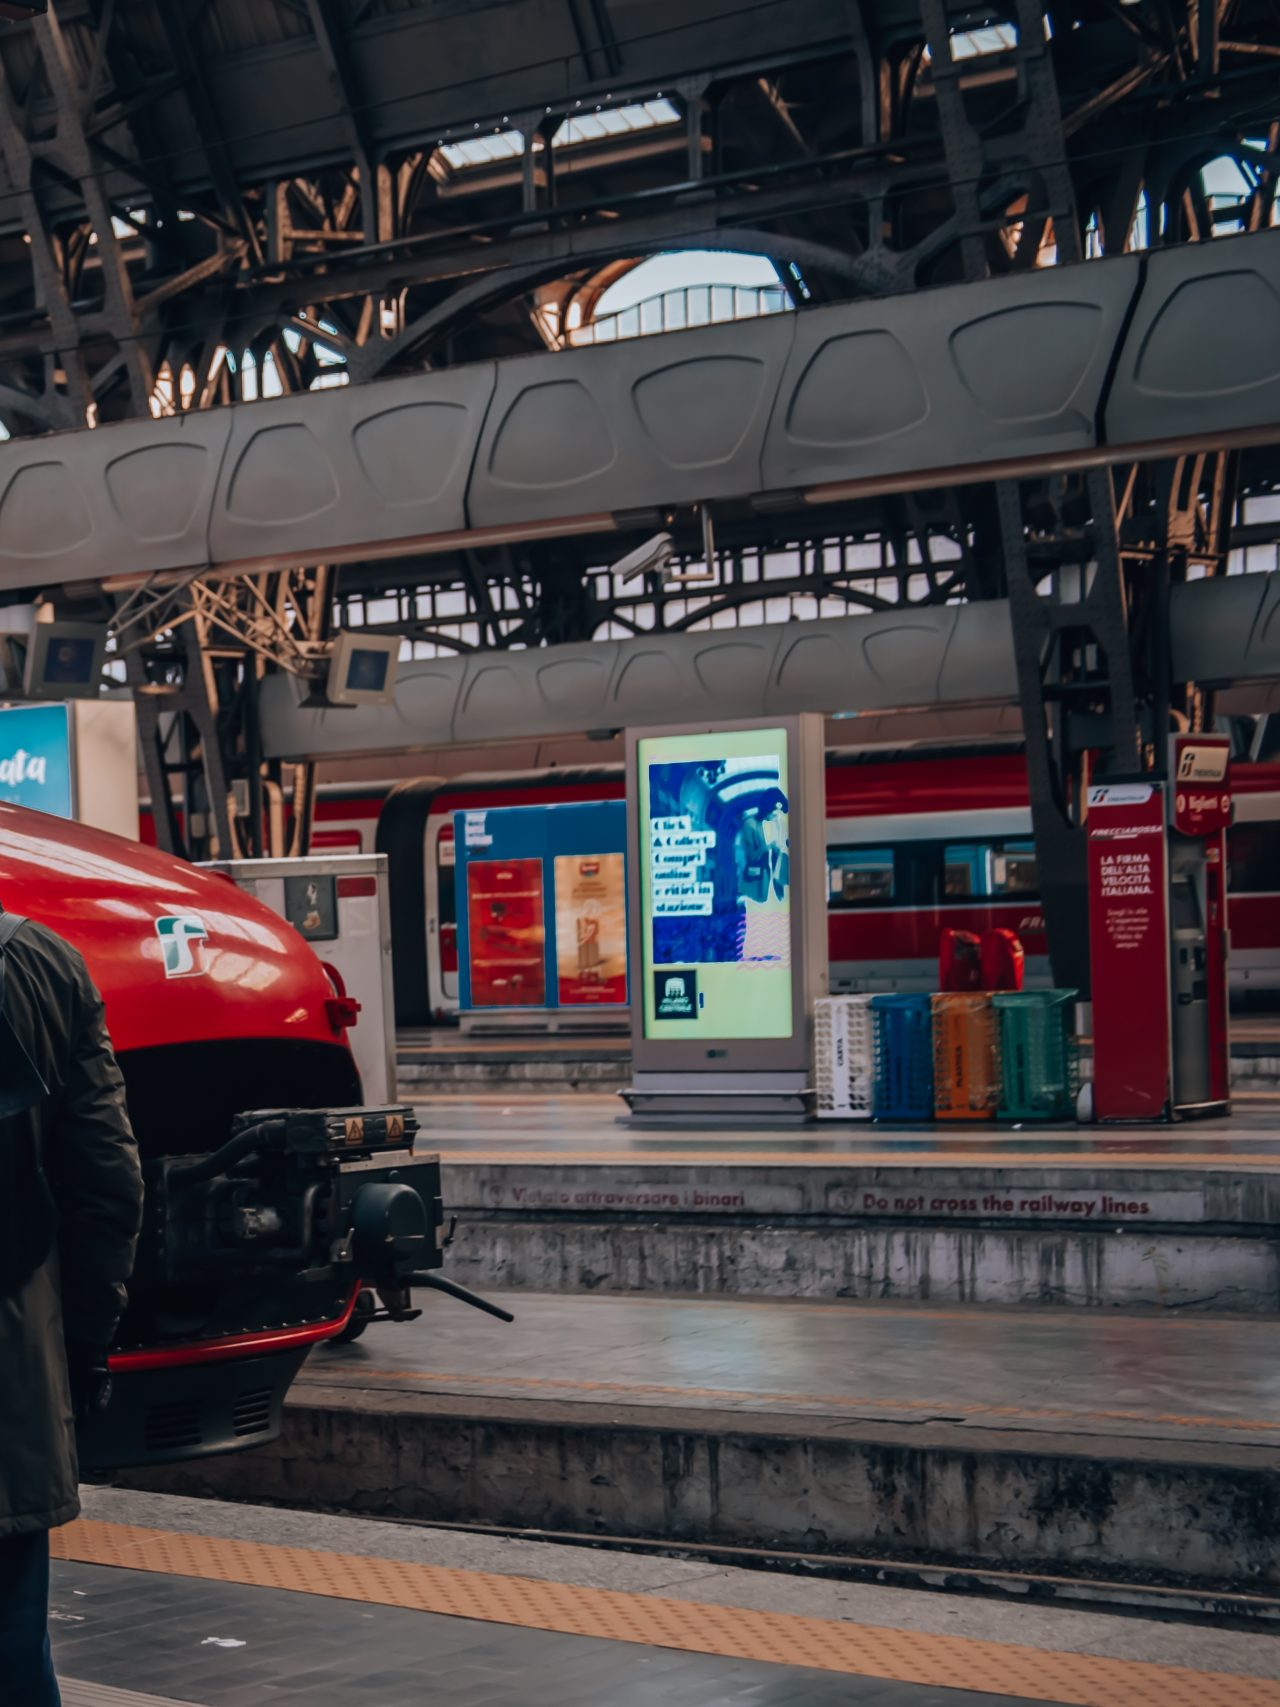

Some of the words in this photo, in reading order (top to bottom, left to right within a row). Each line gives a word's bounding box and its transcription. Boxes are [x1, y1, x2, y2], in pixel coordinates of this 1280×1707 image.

[1091, 825, 1163, 837] FRECCIAROSSA
[1101, 856, 1114, 866] LA
[1116, 854, 1151, 865] FIRMA
[1101, 864, 1150, 876] DELL'ALTA
[1101, 885, 1155, 897] ITALIANA.
[1019, 916, 1046, 929] FR
[693, 1189, 745, 1207] binari
[863, 1193, 889, 1210] Do
[894, 1194, 924, 1211] not
[930, 1197, 977, 1212] cross
[982, 1194, 1014, 1213] the
[1018, 1194, 1096, 1217] railway
[1101, 1196, 1150, 1215] lines
